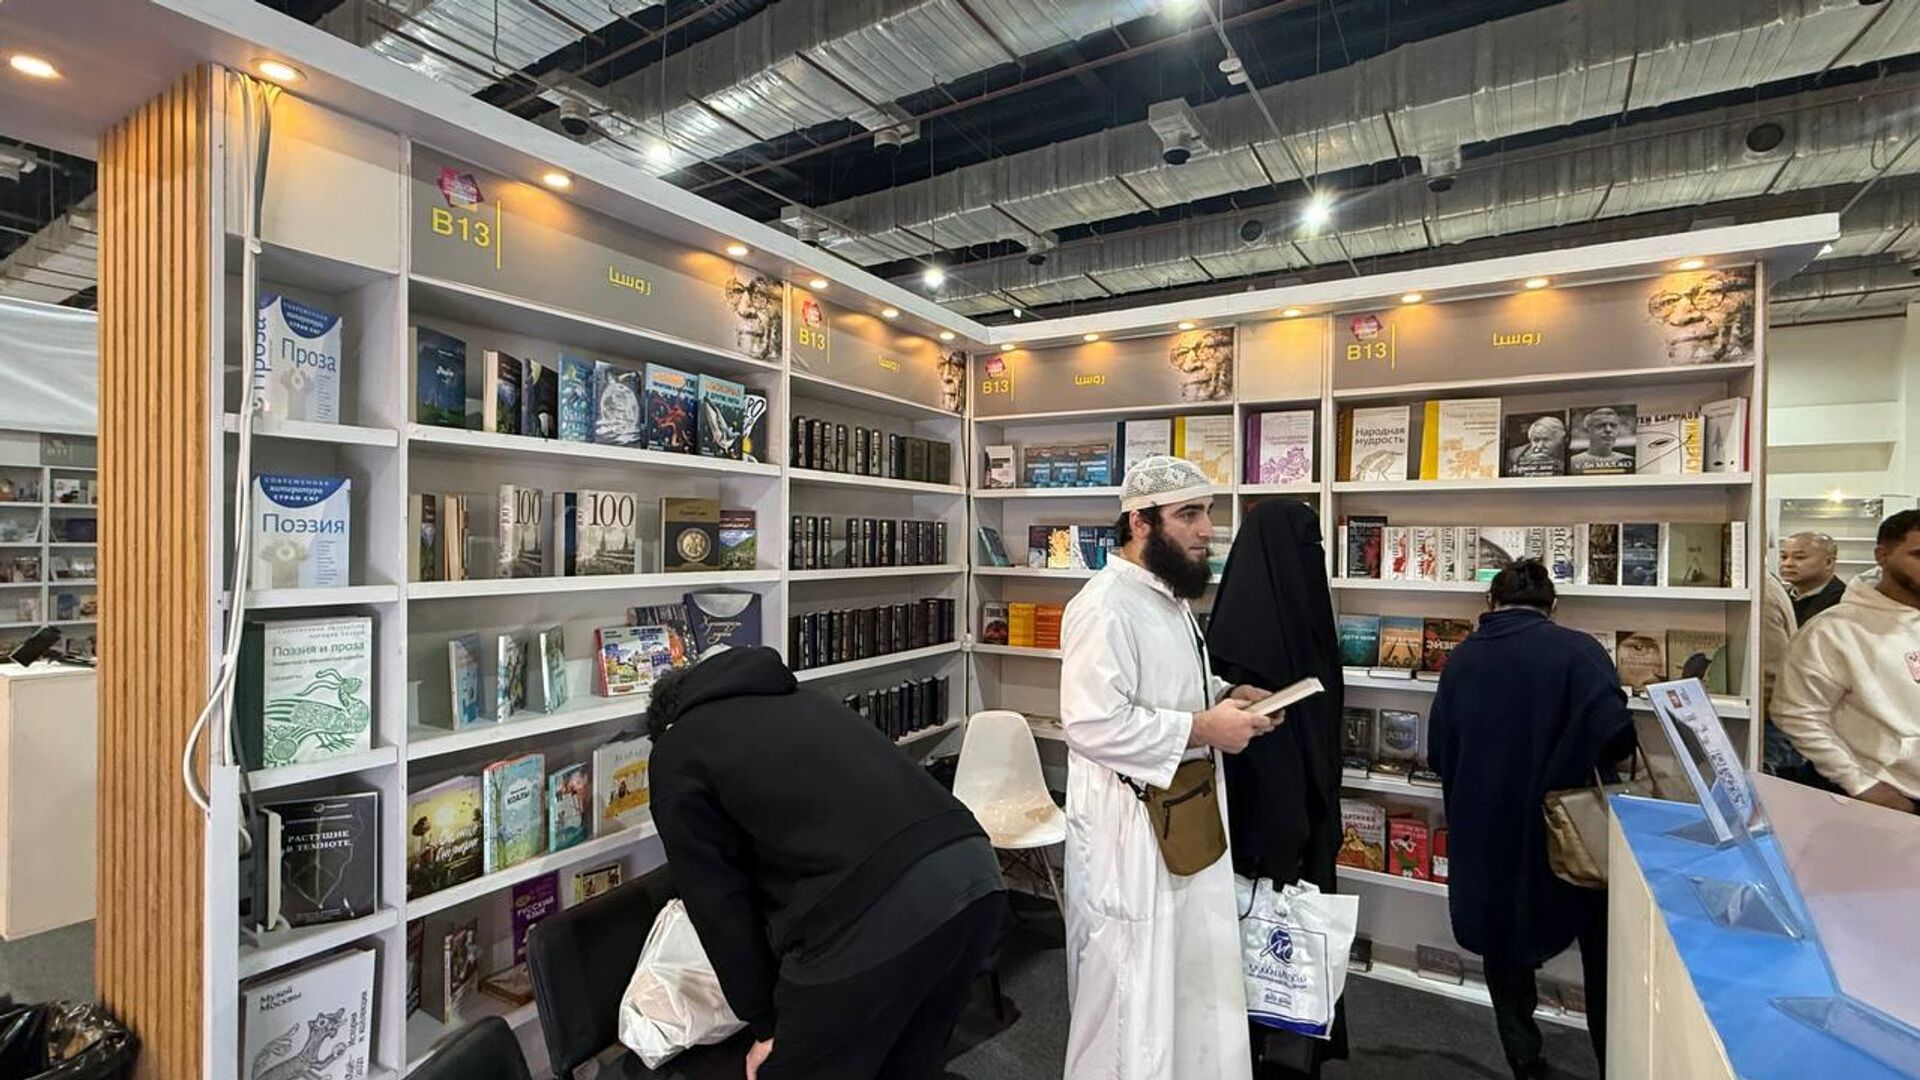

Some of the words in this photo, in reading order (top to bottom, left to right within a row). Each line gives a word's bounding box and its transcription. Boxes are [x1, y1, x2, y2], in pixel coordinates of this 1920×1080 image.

[431, 207, 491, 248] B13
[606, 265, 652, 295] روسيا
[799, 329, 826, 350] B13
[1492, 332, 1541, 347] روسيا
[282, 338, 336, 372] Проза
[1346, 342, 1388, 361] B13
[983, 380, 1010, 394] B13
[1075, 375, 1105, 386] روسيا
[1355, 427, 1405, 437] Народная
[1355, 436, 1405, 447] мудрость
[515, 490, 542, 525] 100
[588, 493, 634, 527] 100
[263, 513, 345, 534] Поэзия
[272, 645, 316, 657] Поэзия
[320, 644, 327, 653] и
[331, 641, 365, 653] проза
